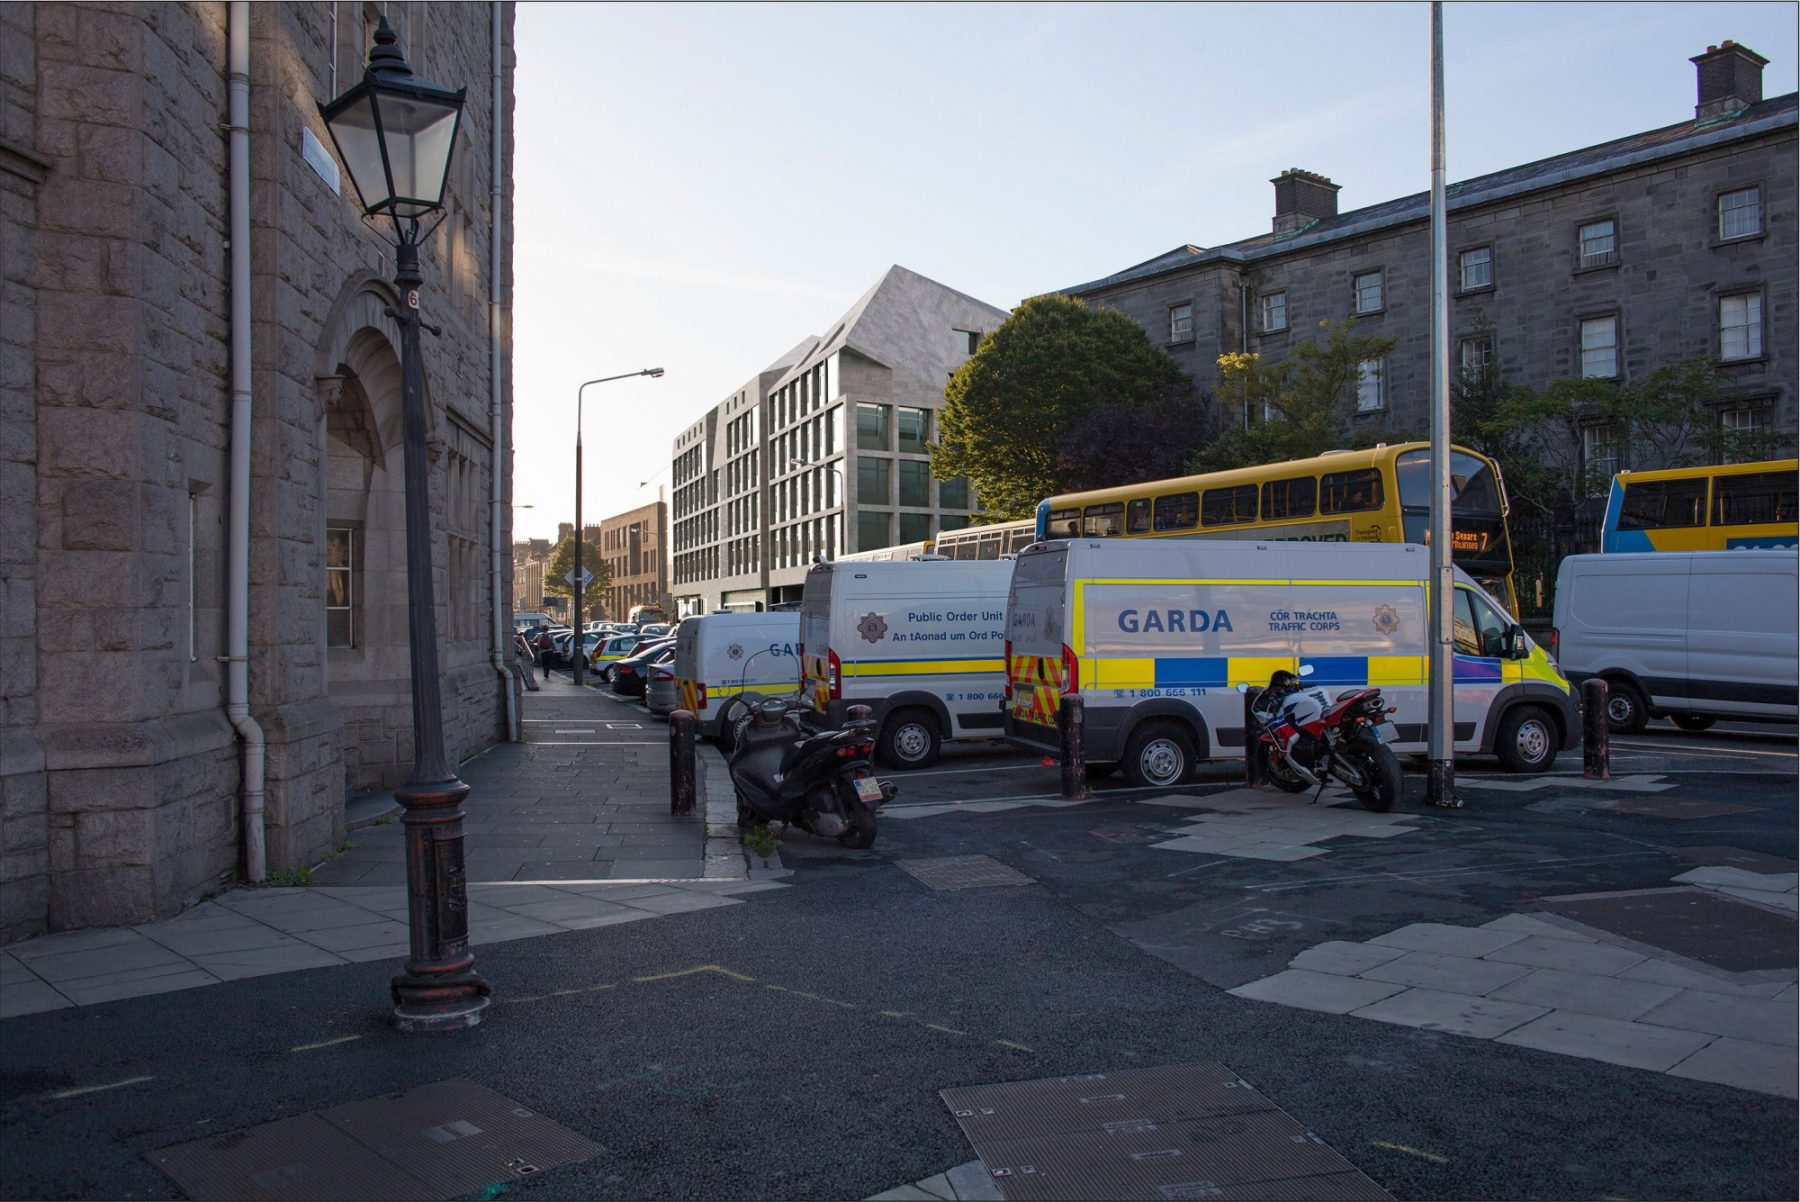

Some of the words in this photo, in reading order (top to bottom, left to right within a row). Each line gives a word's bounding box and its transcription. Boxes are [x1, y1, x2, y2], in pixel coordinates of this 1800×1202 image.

[410, 292, 418, 306] 6
[1481, 532, 1488, 551] 7
[908, 612, 942, 622] Public
[946, 611, 977, 621] Order
[982, 611, 1003, 621] Unit
[1270, 609, 1290, 621] CÓR
[1294, 609, 1337, 621] TRÁCHTA
[1117, 609, 1233, 633] GARDA
[1268, 622, 1306, 632] TRAFFIC
[1309, 622, 1340, 631] CORPS
[892, 632, 906, 641] An
[910, 631, 947, 641] tAonad
[950, 632, 965, 640] um
[968, 630, 988, 640] Ord
[967, 692, 985, 700] 800
[1129, 689, 1136, 698] 1
[1139, 688, 1161, 697] 800
[1165, 688, 1186, 697] 666
[1190, 688, 1207, 697] 111
